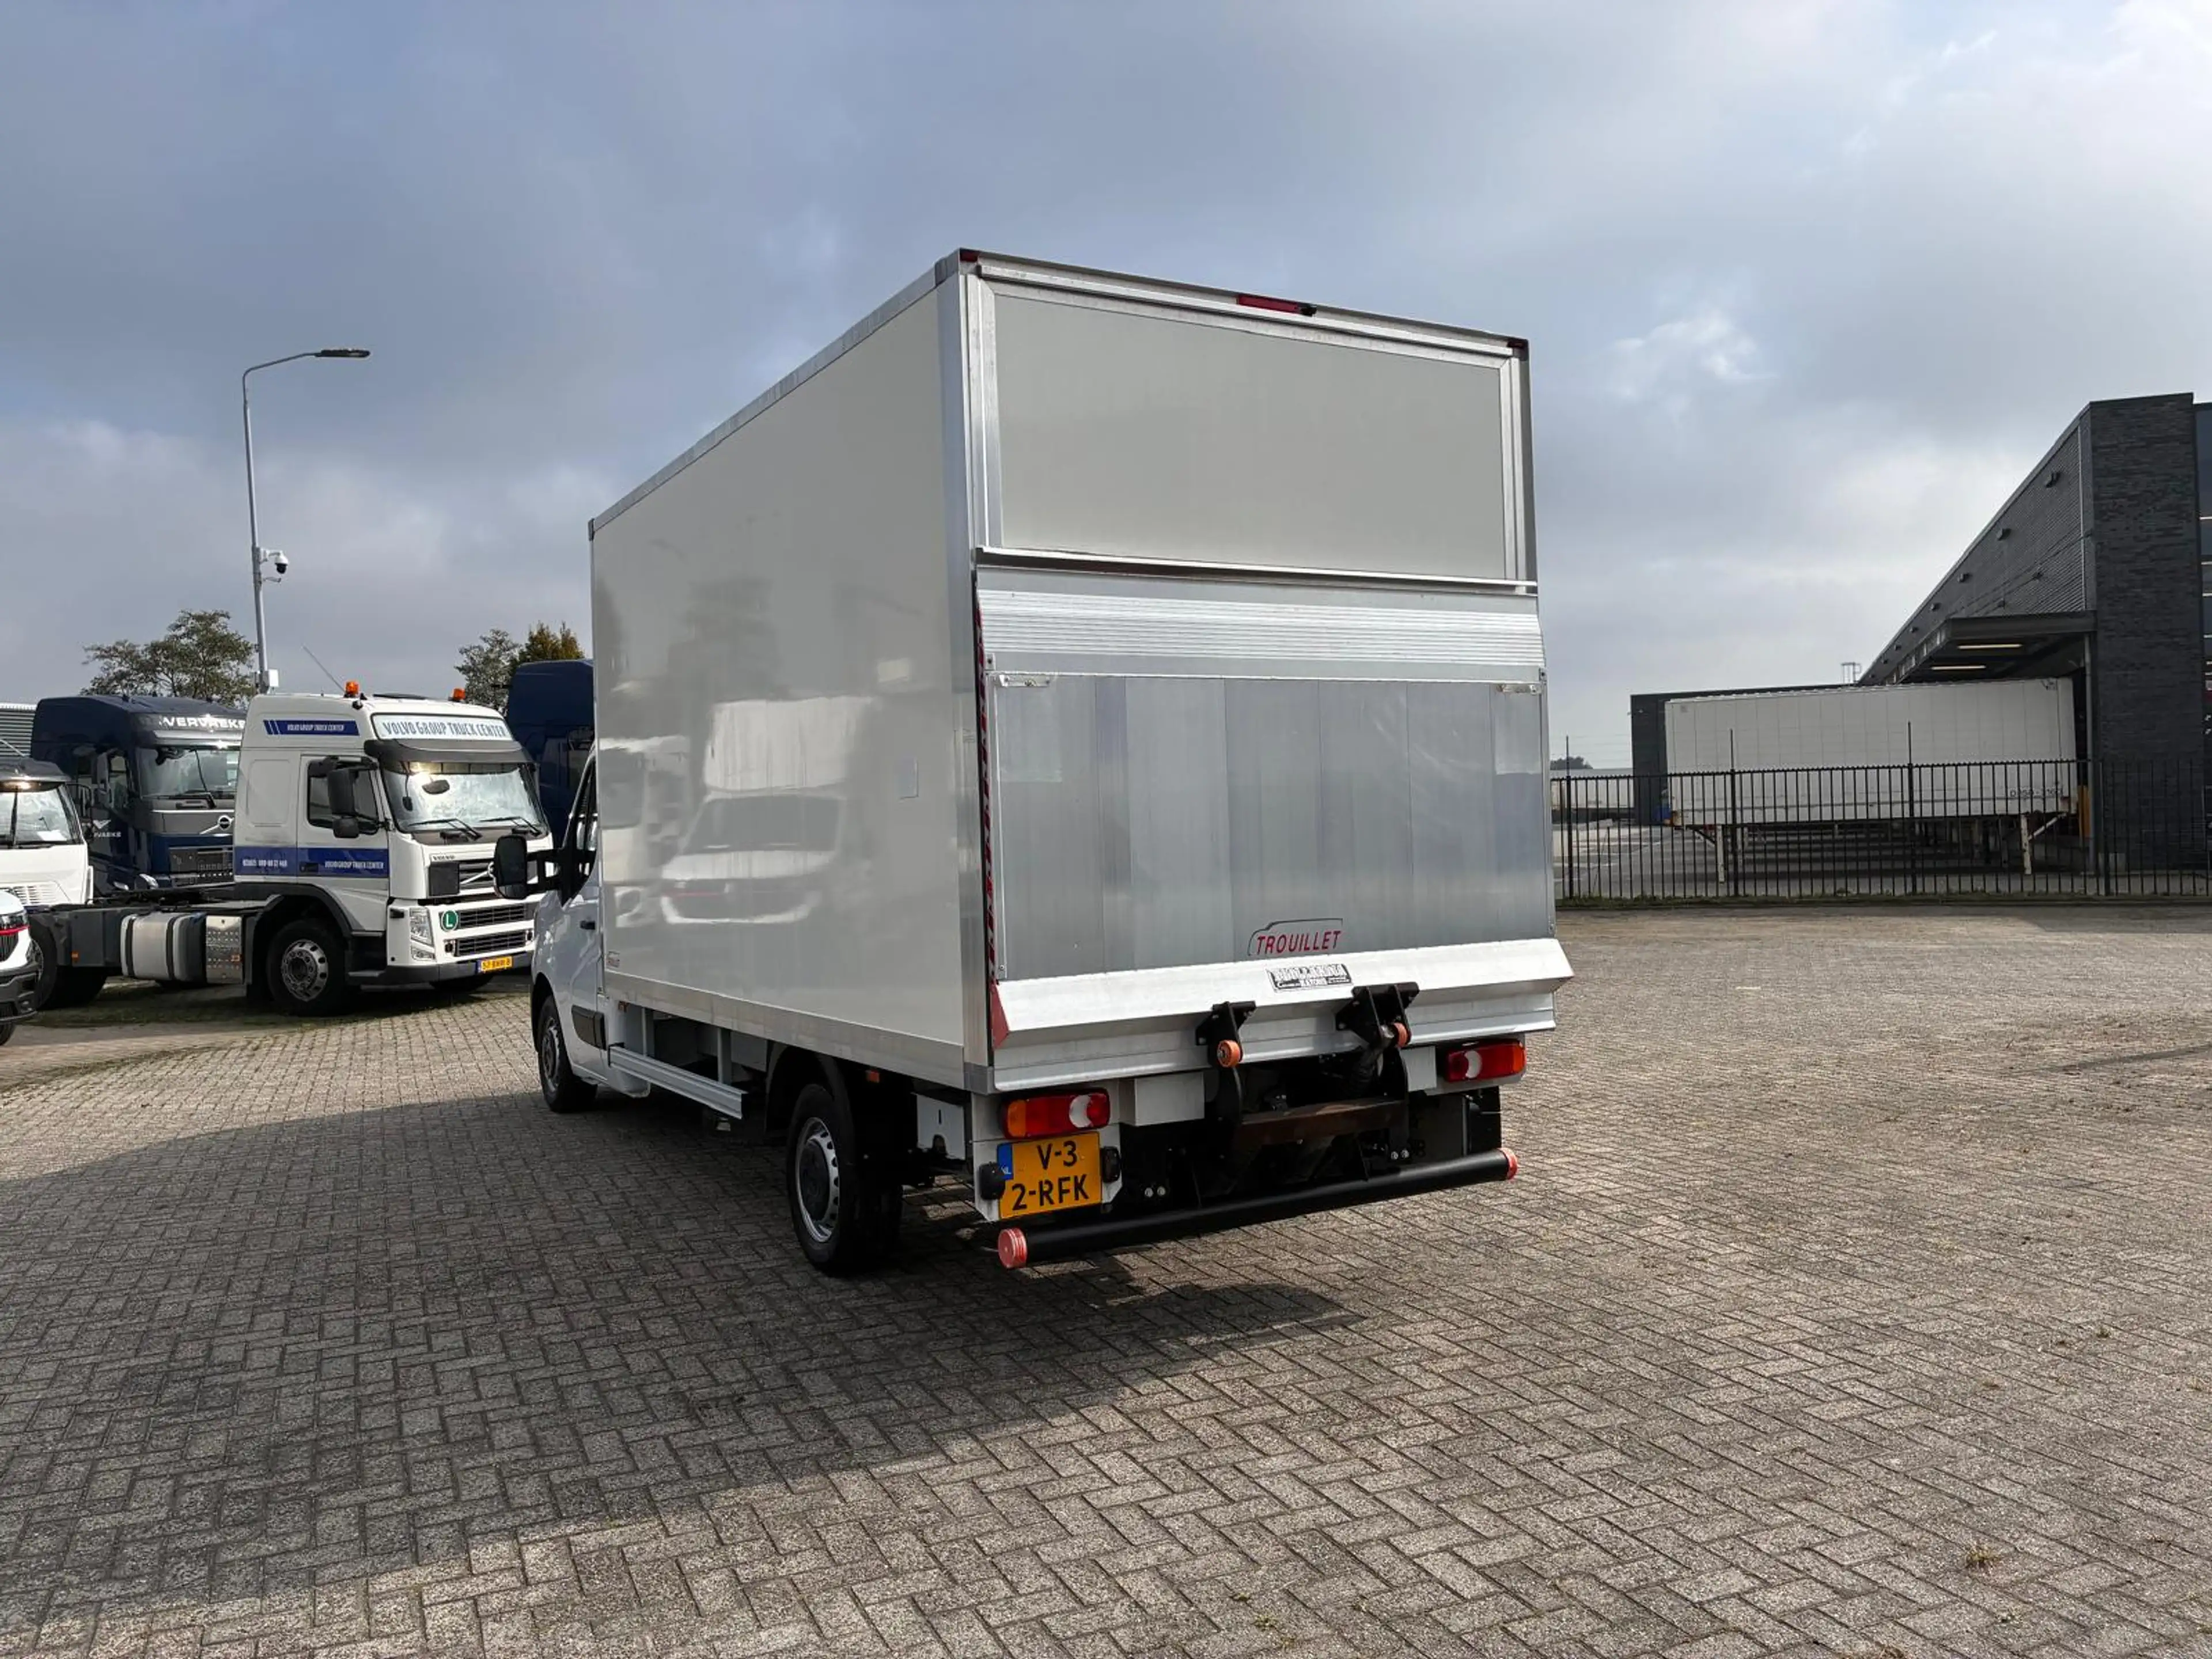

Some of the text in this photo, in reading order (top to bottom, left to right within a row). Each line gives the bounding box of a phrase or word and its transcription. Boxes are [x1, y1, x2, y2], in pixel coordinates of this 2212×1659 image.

[382, 721, 507, 737] VOLVO GROUP TRUCK CENTER
[446, 914, 453, 927] L
[1256, 930, 1342, 955] TROUILLET
[1037, 1141, 1077, 1171] V-3
[1012, 1174, 1089, 1211] 2-RFK
